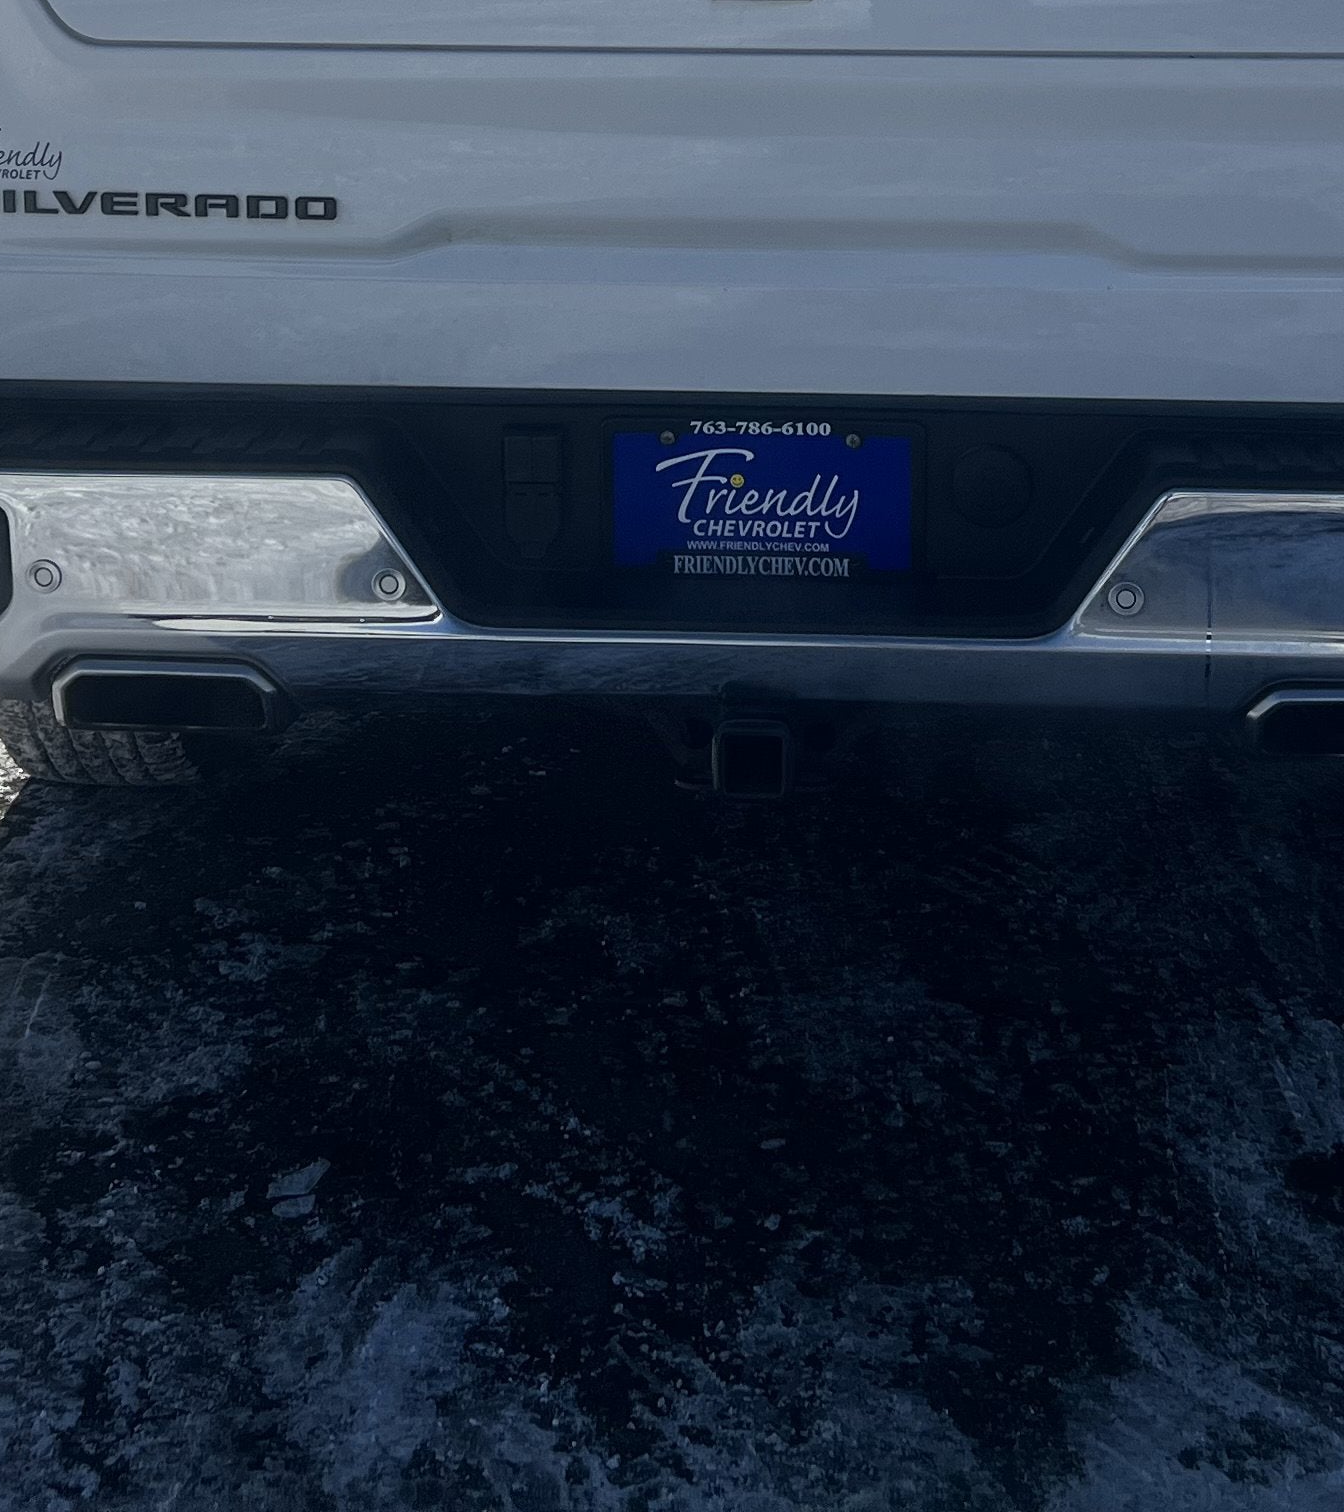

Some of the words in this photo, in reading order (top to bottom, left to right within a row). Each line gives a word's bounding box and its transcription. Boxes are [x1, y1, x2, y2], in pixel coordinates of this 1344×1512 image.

[689, 420, 832, 437] 763-786-6100
[655, 448, 860, 539] Friendly
[692, 518, 821, 539] CHEVROLET
[686, 540, 830, 553] WWW.FRIENDLYCHEV.COM
[673, 554, 851, 578] FRIENDLYCHEV.COM
